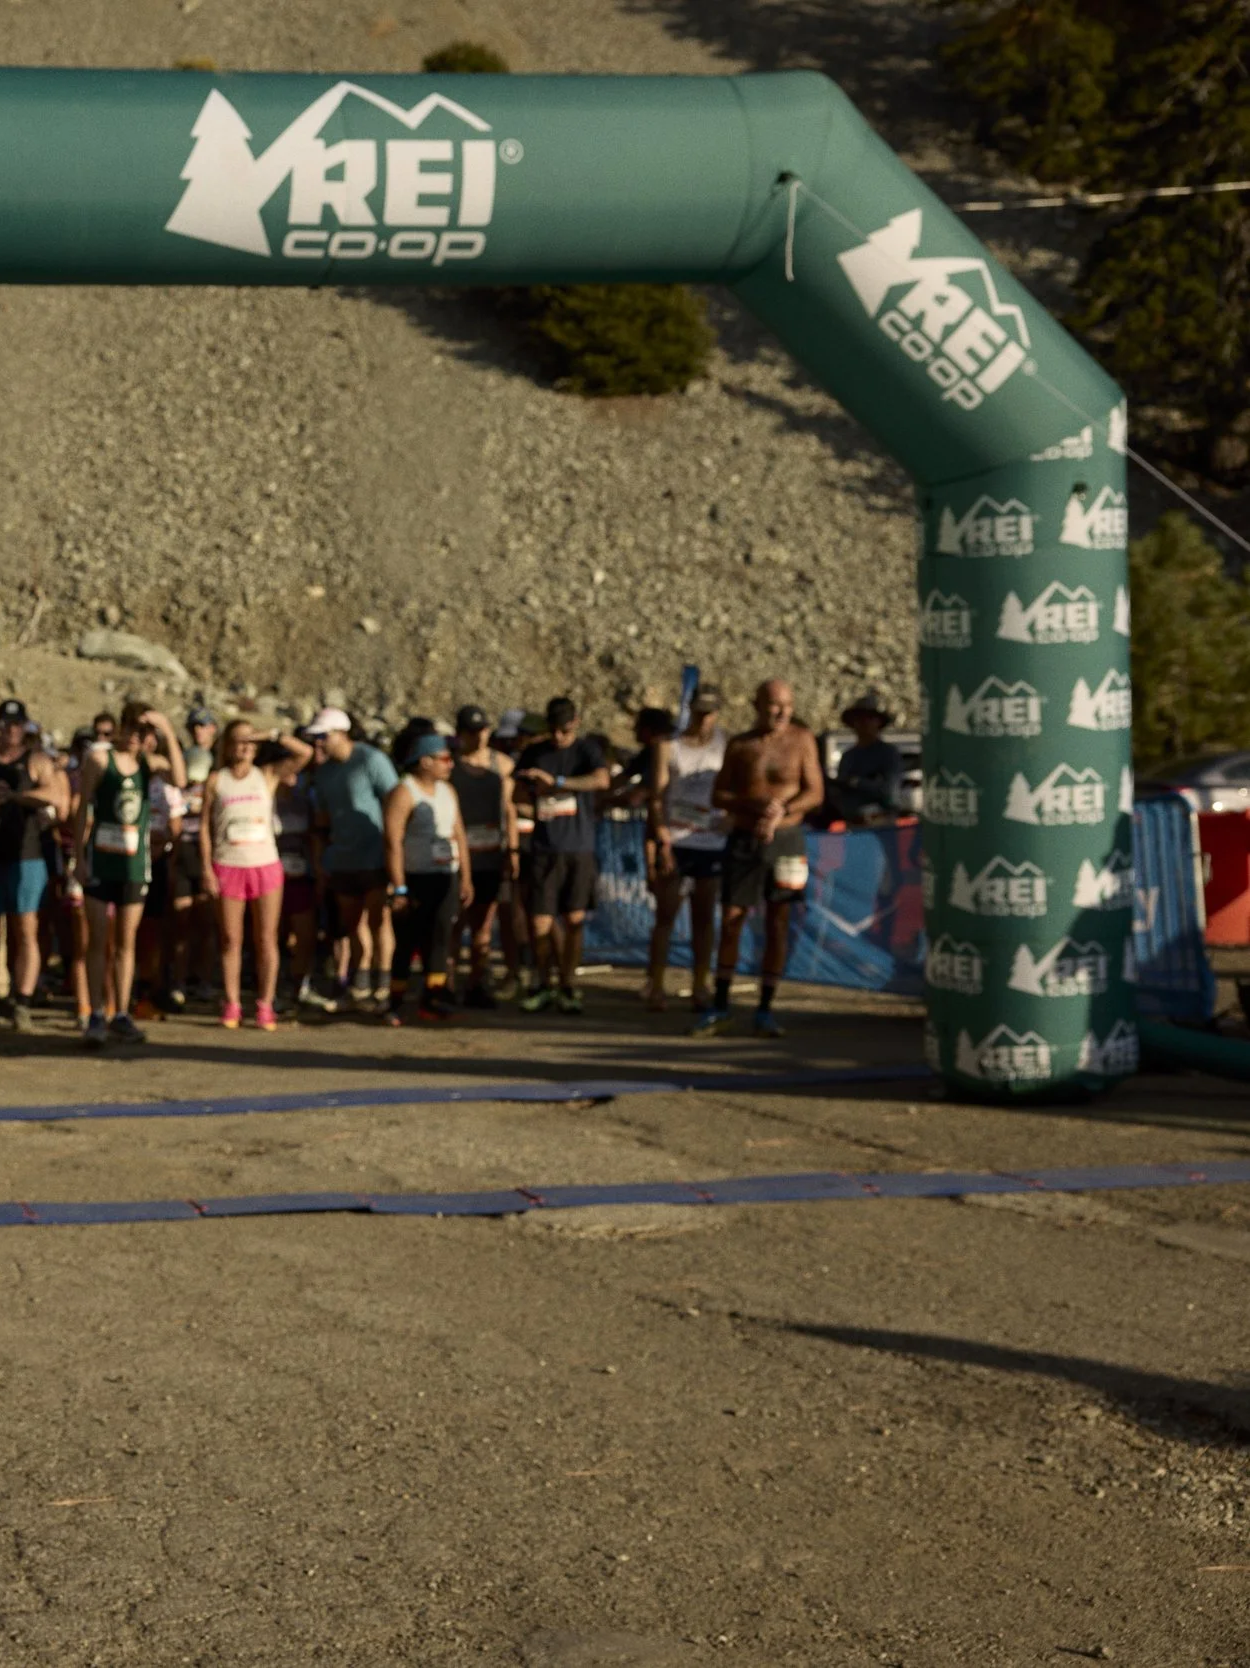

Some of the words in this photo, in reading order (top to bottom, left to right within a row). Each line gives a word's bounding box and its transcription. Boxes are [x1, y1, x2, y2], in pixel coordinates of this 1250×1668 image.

[287, 138, 497, 227] REI
[897, 272, 1027, 395] REI
[967, 515, 1034, 543] REI
[1033, 602, 1099, 632] REI
[971, 696, 1042, 724] REI
[1040, 783, 1105, 812] REI
[980, 876, 1048, 904] REI
